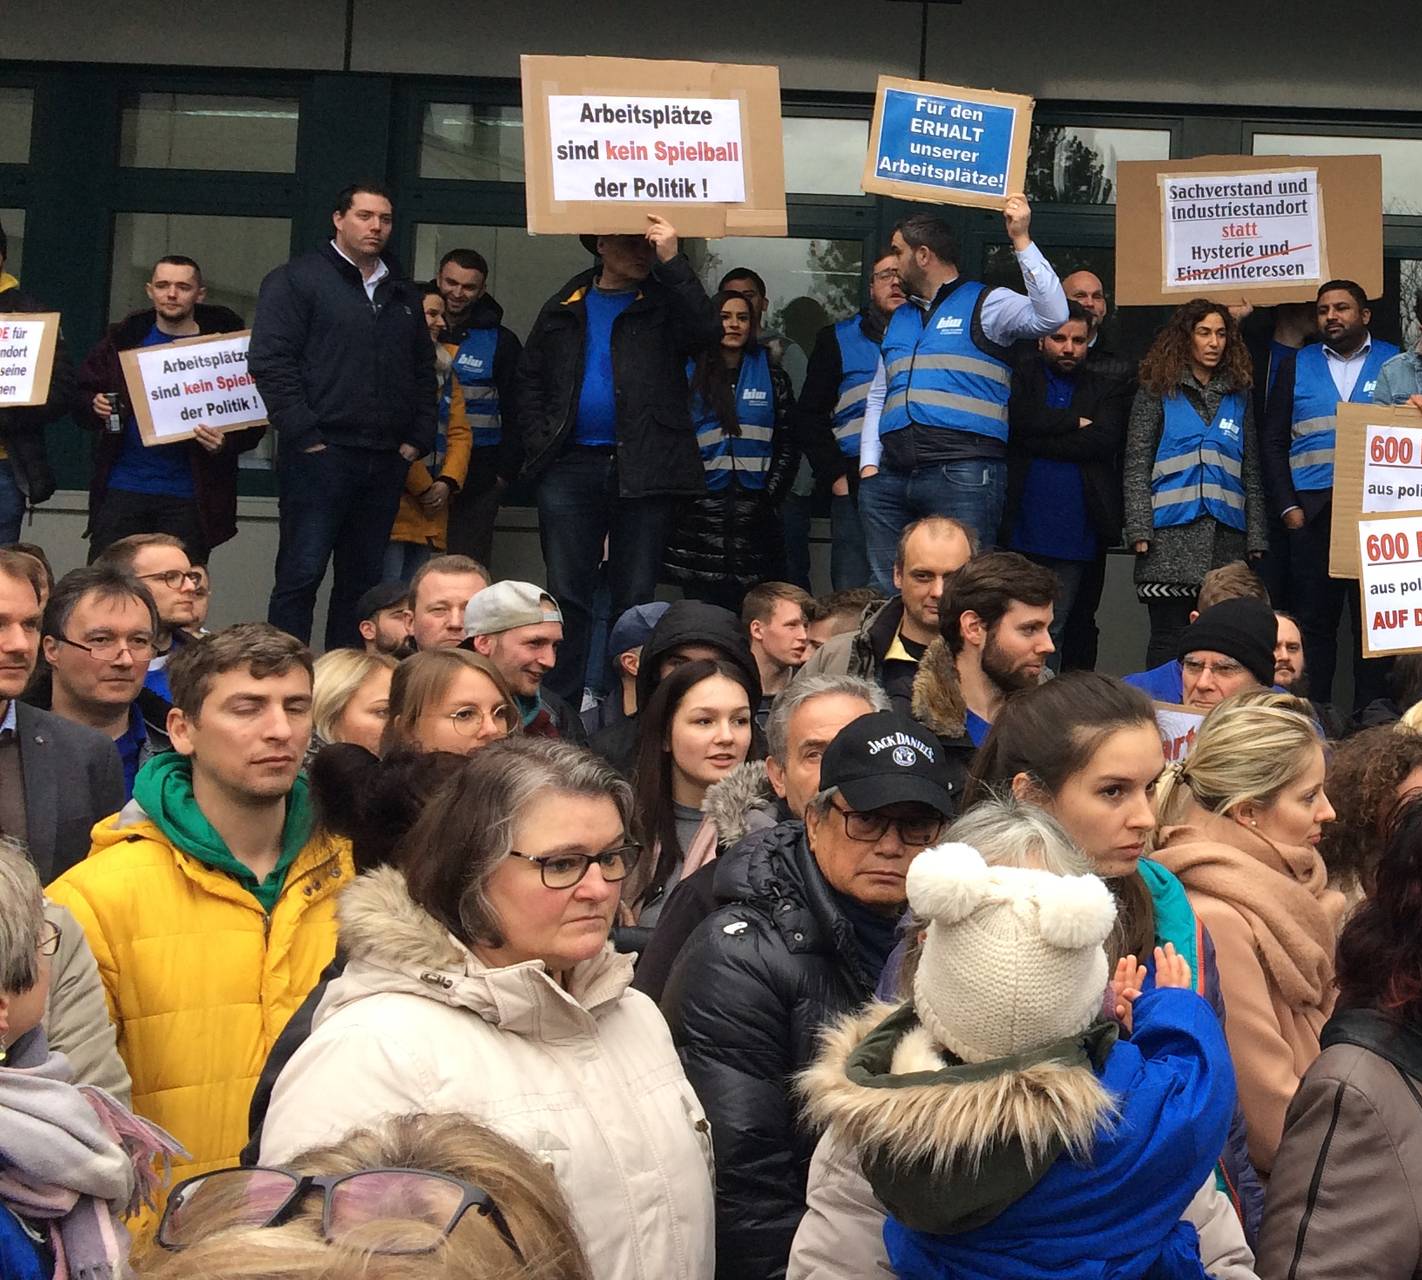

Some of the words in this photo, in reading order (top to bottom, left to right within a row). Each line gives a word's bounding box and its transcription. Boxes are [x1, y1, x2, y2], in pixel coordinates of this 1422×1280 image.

[580, 103, 712, 129] Arbeitsplätze
[916, 98, 945, 115] Für
[950, 104, 983, 122] den
[910, 118, 984, 142] ERHALT
[557, 140, 599, 160] sind
[605, 140, 648, 161] kein
[654, 141, 739, 165] Spielball
[910, 142, 980, 163] unserer
[879, 156, 1004, 188] Arbeitsplätze!
[594, 177, 627, 198] der
[633, 178, 697, 199] Politik
[702, 179, 708, 198] !
[1169, 180, 1272, 200] Sachverstand
[1278, 178, 1308, 195] und
[1172, 199, 1308, 220] Industriestandort
[1222, 222, 1258, 238] statt
[1192, 243, 1254, 263] Hysterie
[1259, 240, 1289, 257] und
[1177, 263, 1305, 281] Einzelinteressen
[12, 327, 28, 339] für
[0, 364, 27, 376] seine
[151, 383, 180, 401] sind
[183, 379, 213, 395] kein
[180, 407, 202, 421] der
[206, 398, 250, 416] Politik
[1370, 435, 1413, 464] 600
[1368, 483, 1393, 496] aus
[1366, 533, 1409, 561] 600
[1370, 583, 1396, 595] aus
[1372, 609, 1408, 630] AUF
[867, 735, 896, 755] JACK
